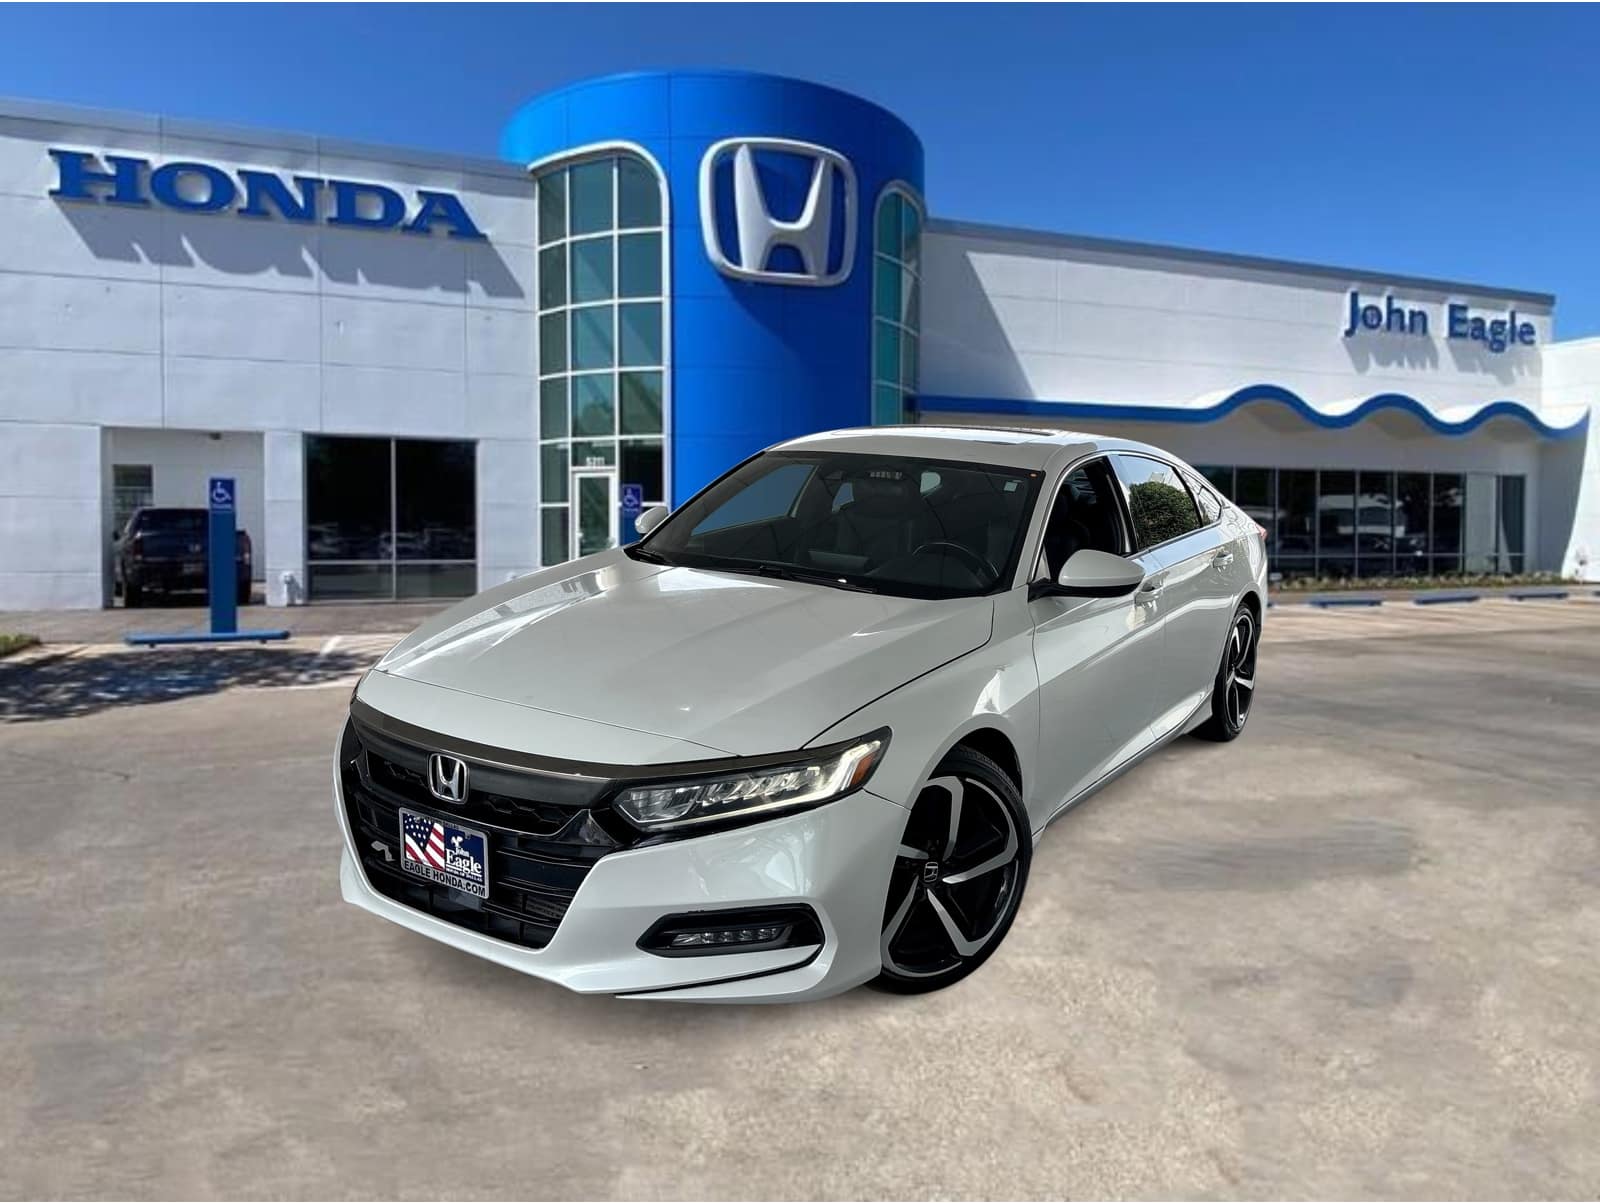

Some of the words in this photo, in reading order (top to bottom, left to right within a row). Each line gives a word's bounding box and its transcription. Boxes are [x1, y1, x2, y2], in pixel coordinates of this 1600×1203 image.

[48, 147, 488, 241] HONDA
[1344, 290, 1428, 338] John
[1447, 302, 1536, 354] Eagle
[404, 861, 431, 878] EAGLE
[433, 869, 486, 897] HONDA.COM
[445, 848, 482, 874] Eagle
